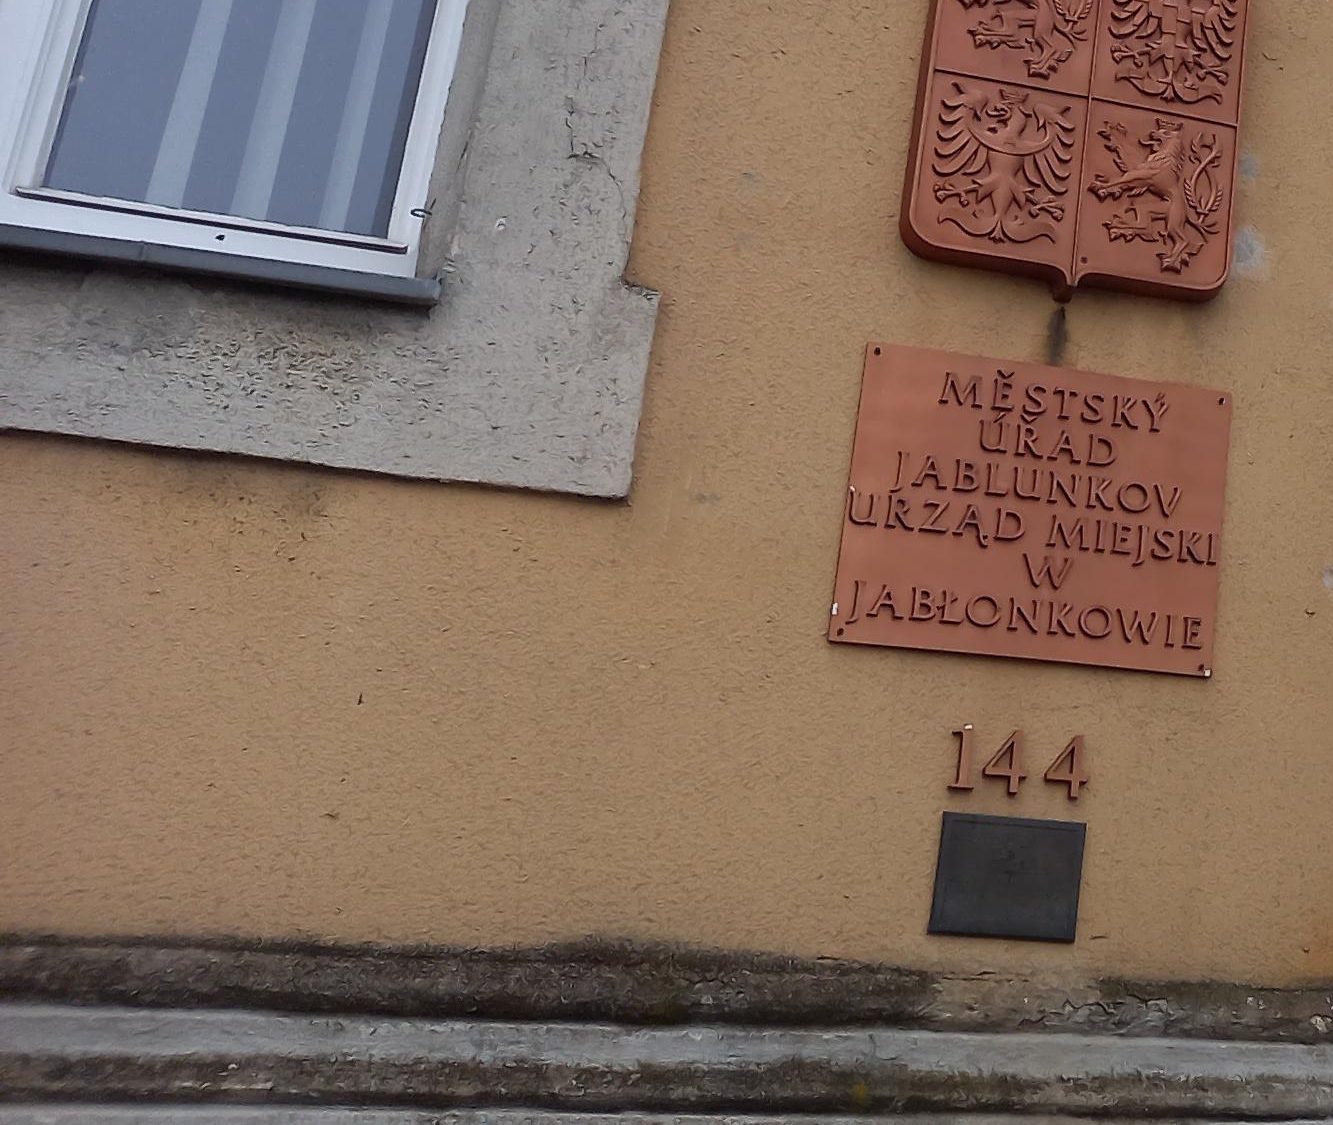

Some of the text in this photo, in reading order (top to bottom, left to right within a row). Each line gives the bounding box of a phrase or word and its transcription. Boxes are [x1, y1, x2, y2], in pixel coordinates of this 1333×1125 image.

[937, 368, 1170, 433] MĚSTSKÝ
[978, 411, 1119, 467] ÚŘAD
[890, 450, 1184, 518] JABLUNKOV
[848, 488, 1218, 567] URZĄD MIEJSKI
[1022, 552, 1074, 591] W
[845, 580, 1205, 650] JABŁONKOWIE
[946, 724, 1090, 801] 144
